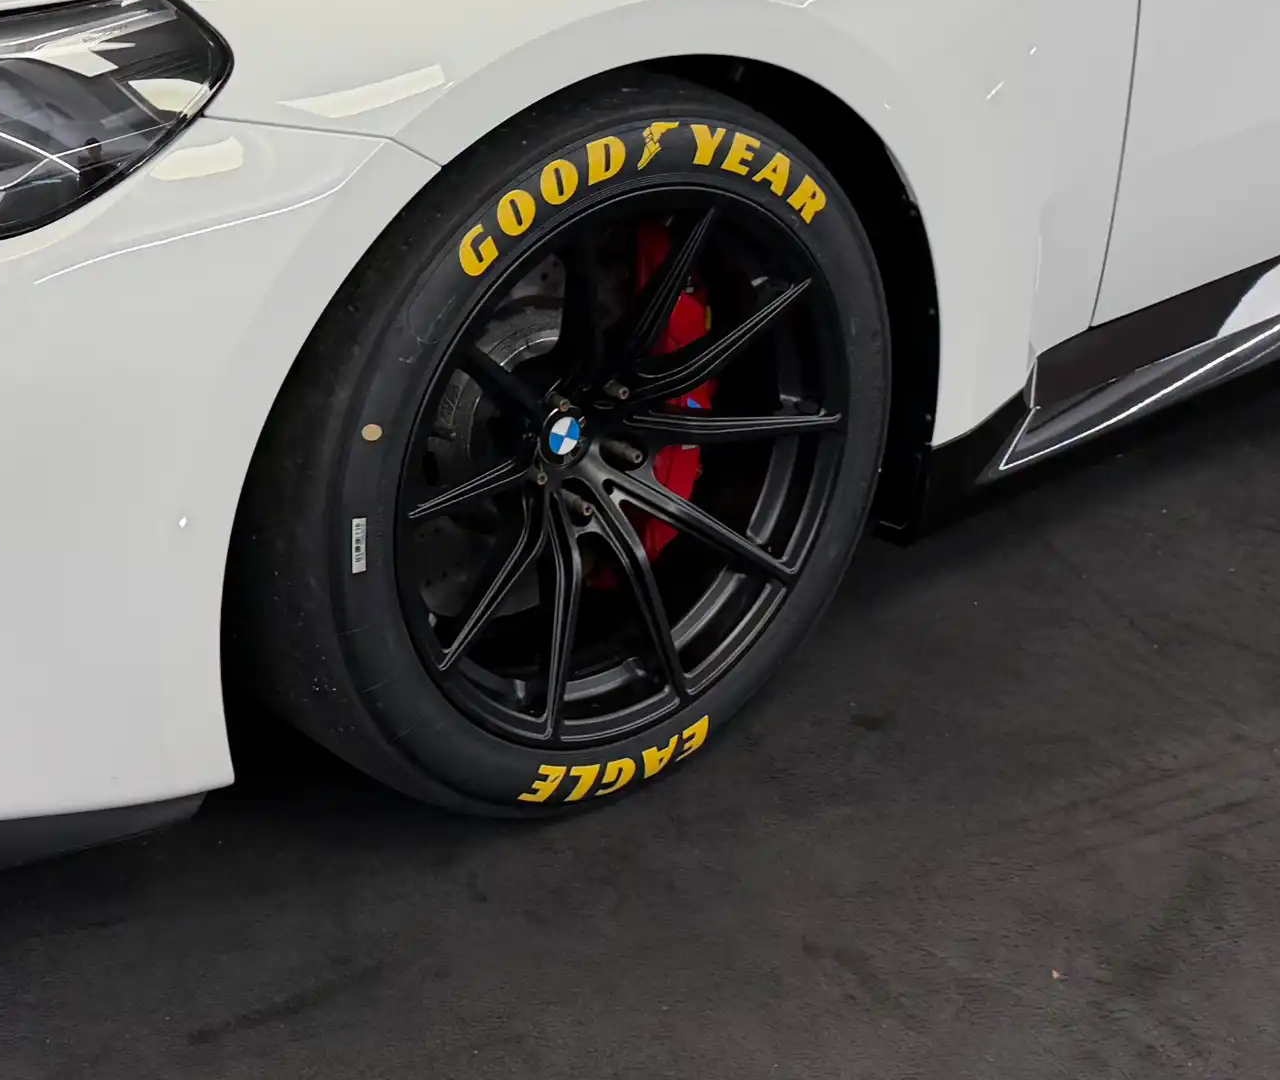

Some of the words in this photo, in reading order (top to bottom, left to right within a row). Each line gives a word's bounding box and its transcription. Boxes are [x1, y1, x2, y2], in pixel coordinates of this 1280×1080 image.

[458, 135, 626, 277] GOOD
[690, 123, 828, 225] YEAR
[516, 714, 710, 803] EAGLE
